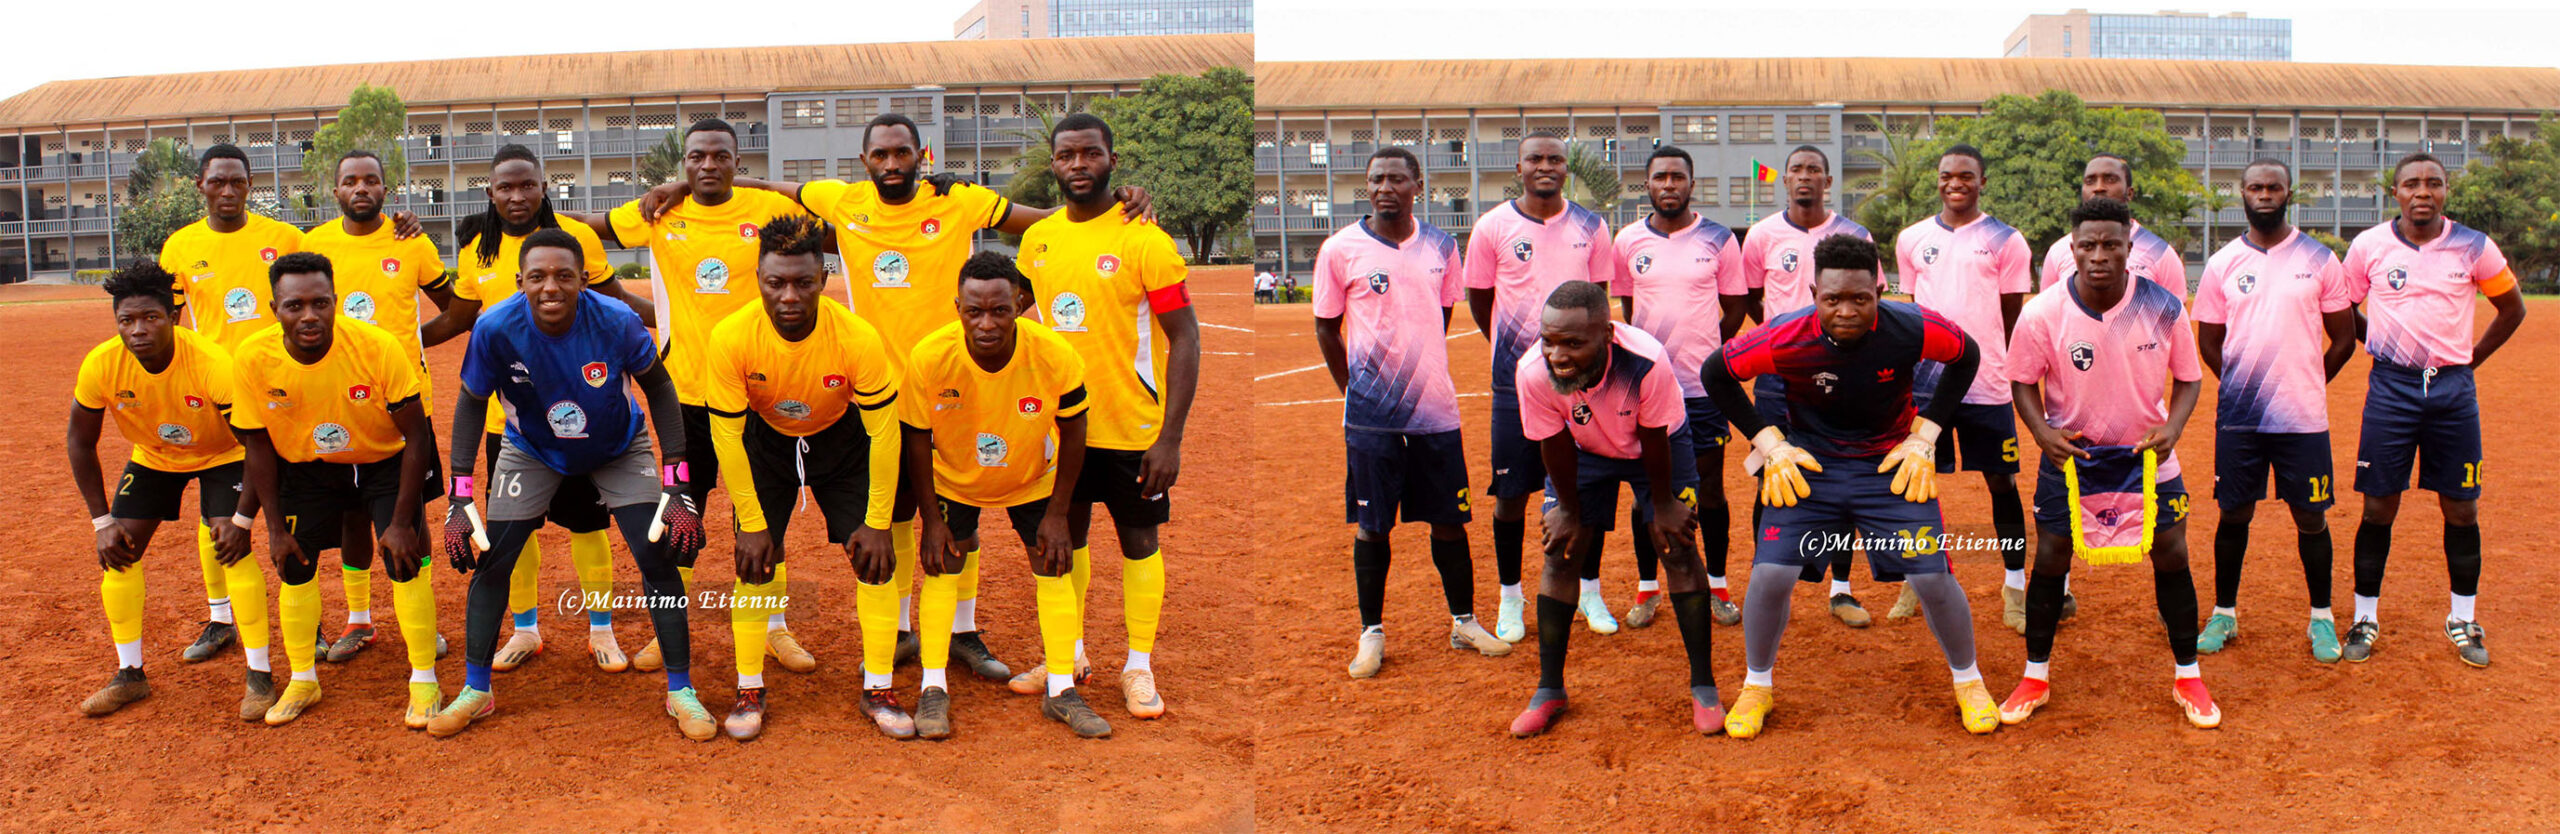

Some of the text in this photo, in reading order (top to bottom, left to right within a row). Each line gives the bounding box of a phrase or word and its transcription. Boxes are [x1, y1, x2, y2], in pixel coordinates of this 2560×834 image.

[2002, 437, 2019, 462] 5
[119, 473, 135, 496] 2
[497, 472, 522, 498] 16
[2308, 474, 2330, 502] 12
[1457, 487, 1472, 512] 3
[286, 515, 298, 535] 7
